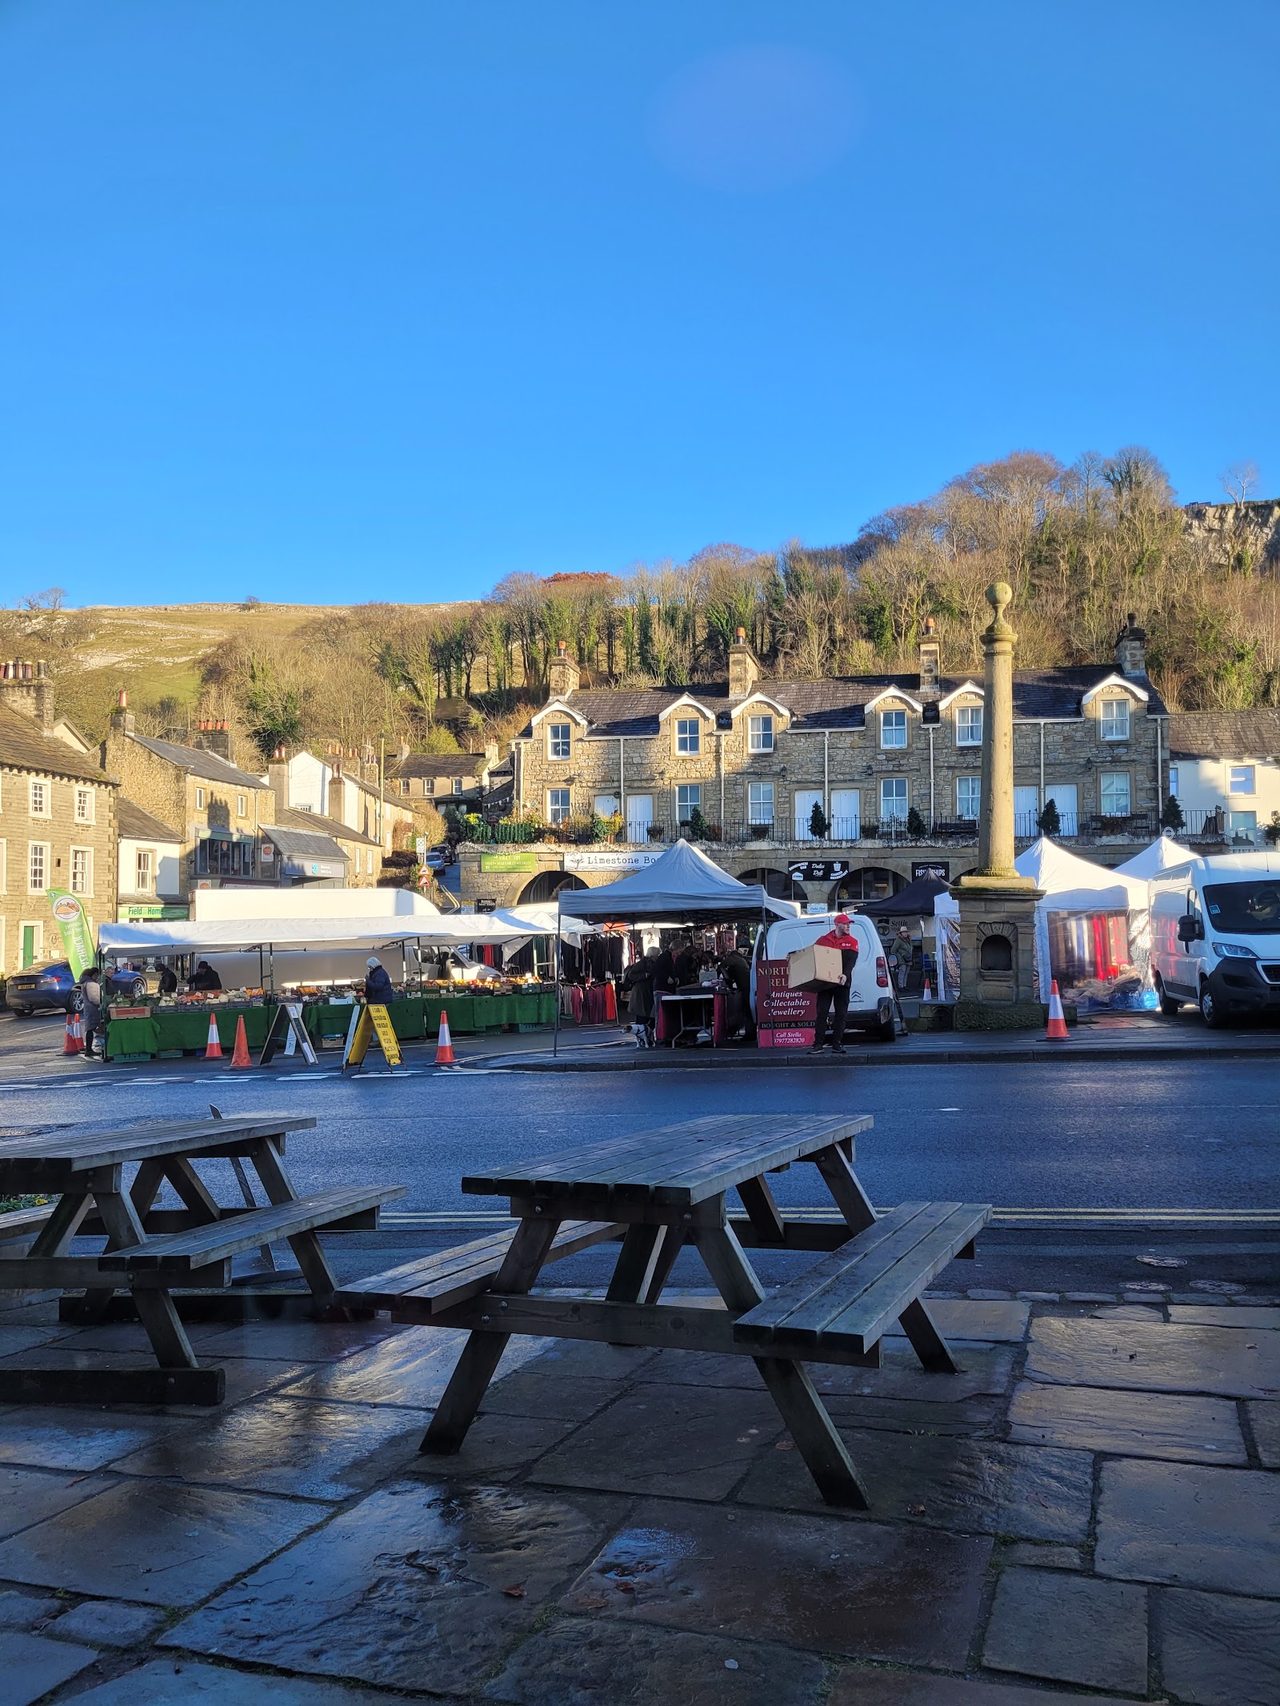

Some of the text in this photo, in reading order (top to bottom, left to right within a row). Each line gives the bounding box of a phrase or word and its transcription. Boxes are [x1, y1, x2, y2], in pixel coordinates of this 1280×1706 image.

[587, 856, 656, 864] Limestone Bo
[769, 978, 788, 987] REL
[768, 1008, 805, 1016] Jewellery
